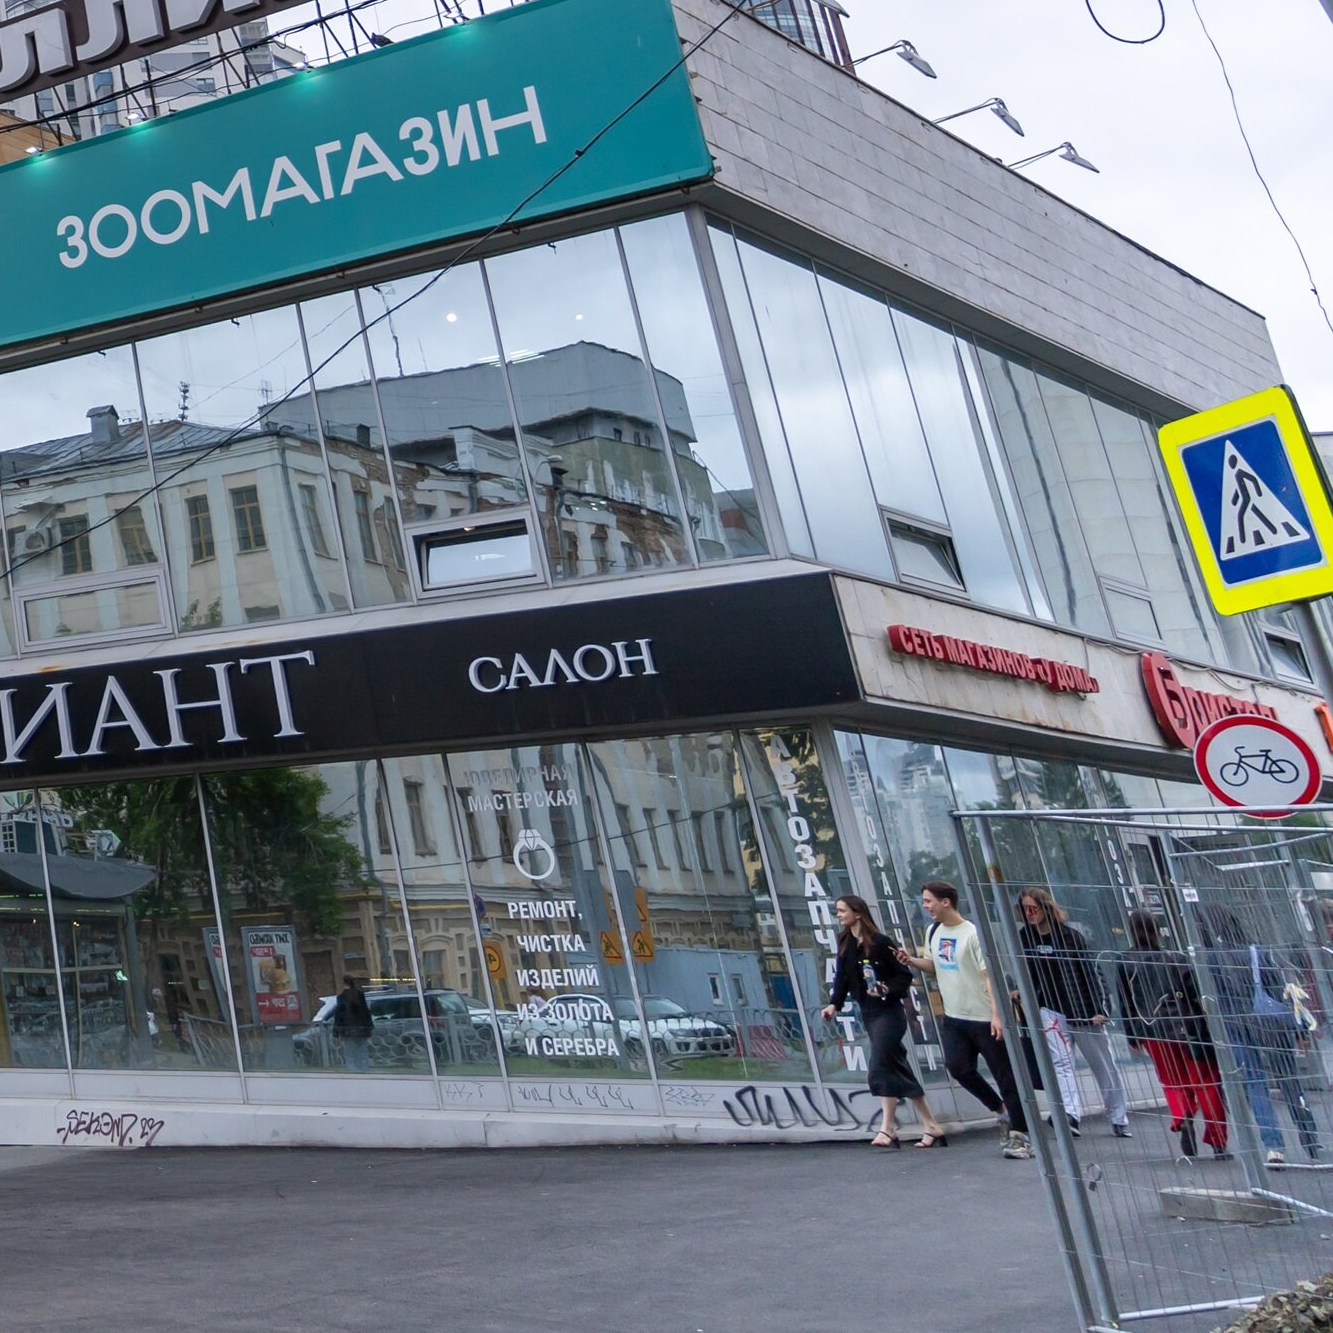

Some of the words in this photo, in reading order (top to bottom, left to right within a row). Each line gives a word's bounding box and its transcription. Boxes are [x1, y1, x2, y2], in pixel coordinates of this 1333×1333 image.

[56, 85, 548, 269] ЗООМАГАЗИН
[895, 625, 945, 660] СЕТЬ
[943, 635, 1035, 680] МАГАЗИНОВ
[468, 638, 660, 693] САЛОН
[468, 788, 579, 812] МАСТЕРСКАЯ
[507, 900, 583, 920] РЕМОНТ,
[517, 934, 587, 953] ЧИСТКА
[517, 964, 600, 990] ИЗДЕЛИЙ
[517, 1003, 539, 1021] ИЗ
[545, 1002, 615, 1021] ЗОЛОТА
[525, 1038, 539, 1056] И
[542, 1038, 620, 1056] СЕРЕБРА
